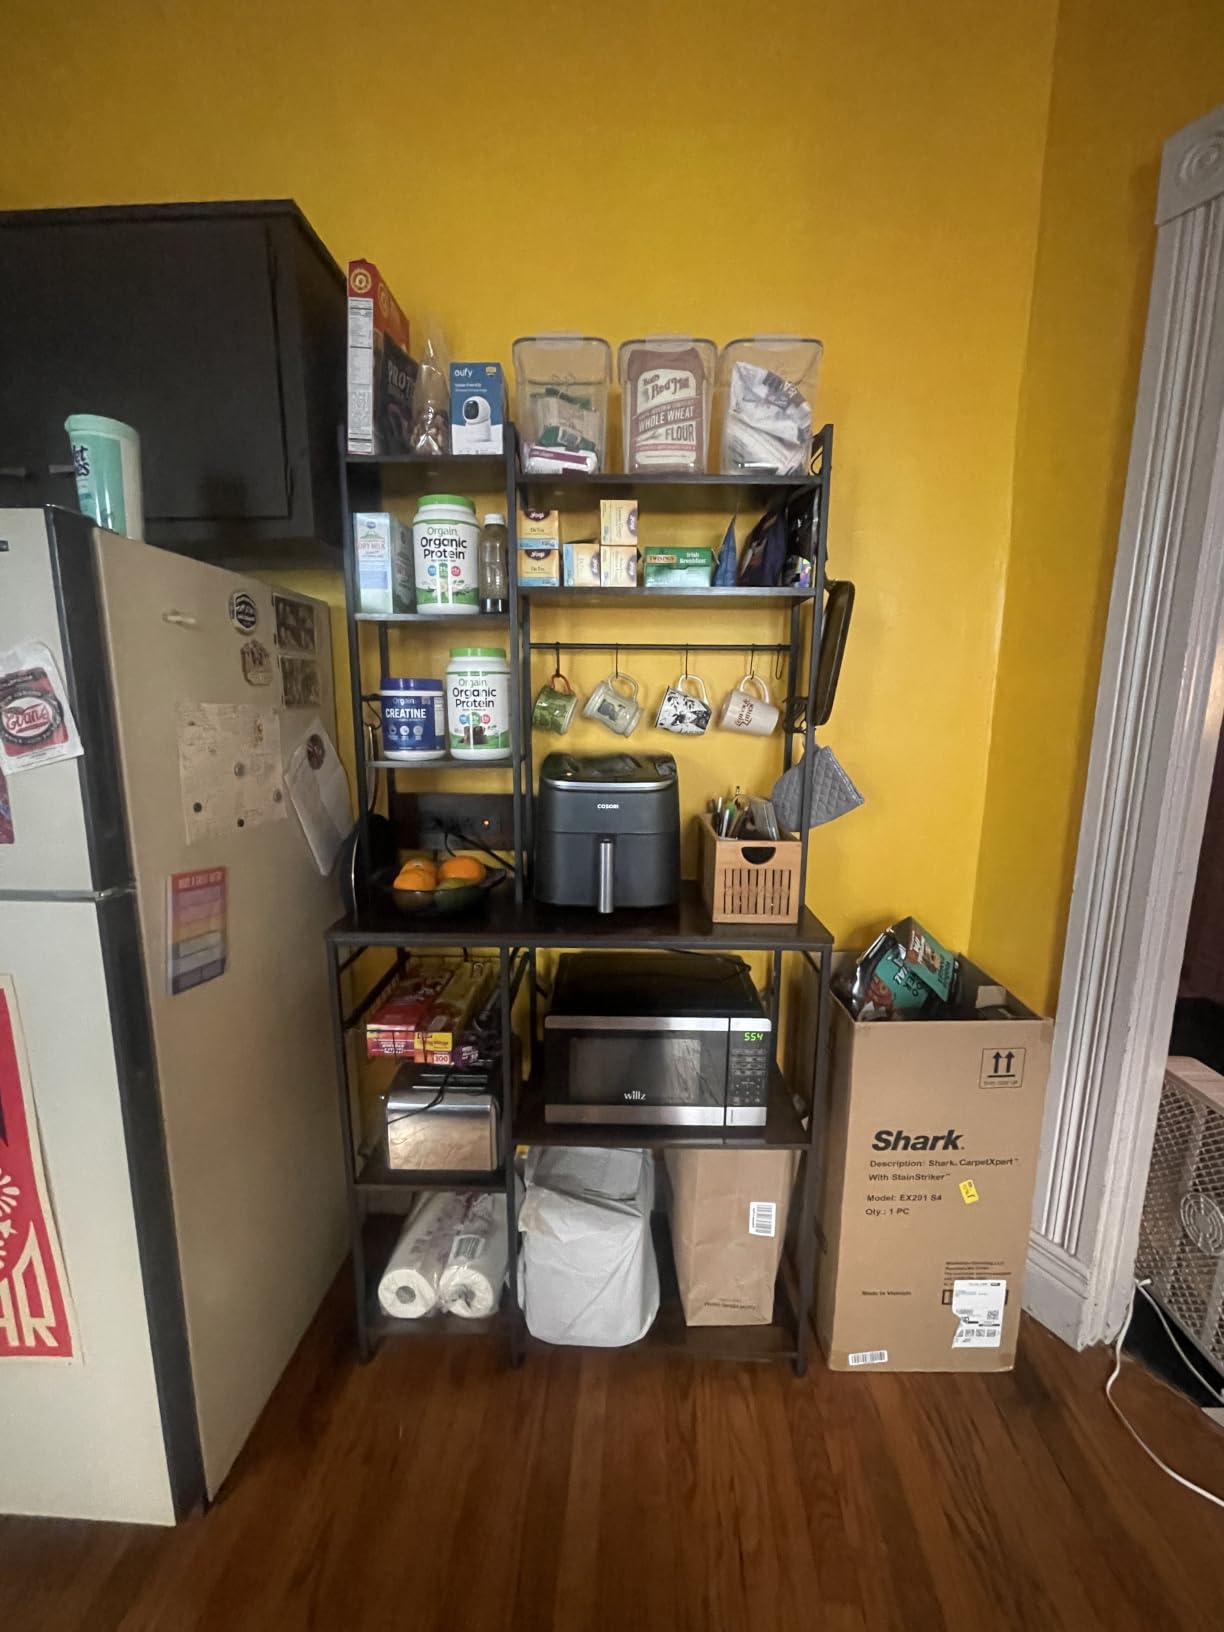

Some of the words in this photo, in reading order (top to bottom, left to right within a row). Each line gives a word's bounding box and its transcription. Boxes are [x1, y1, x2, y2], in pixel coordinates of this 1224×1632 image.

[639, 412, 665, 432] WHOLE
[667, 406, 694, 422] WHEAT
[665, 423, 695, 442] FLOUR
[427, 526, 458, 536] Orgain
[420, 536, 467, 549] Organic
[423, 549, 465, 560] Protein
[452, 687, 497, 699] Organic
[455, 698, 495, 708] Protein
[385, 708, 427, 718] CREATINE
[868, 1173, 889, 1181] With
